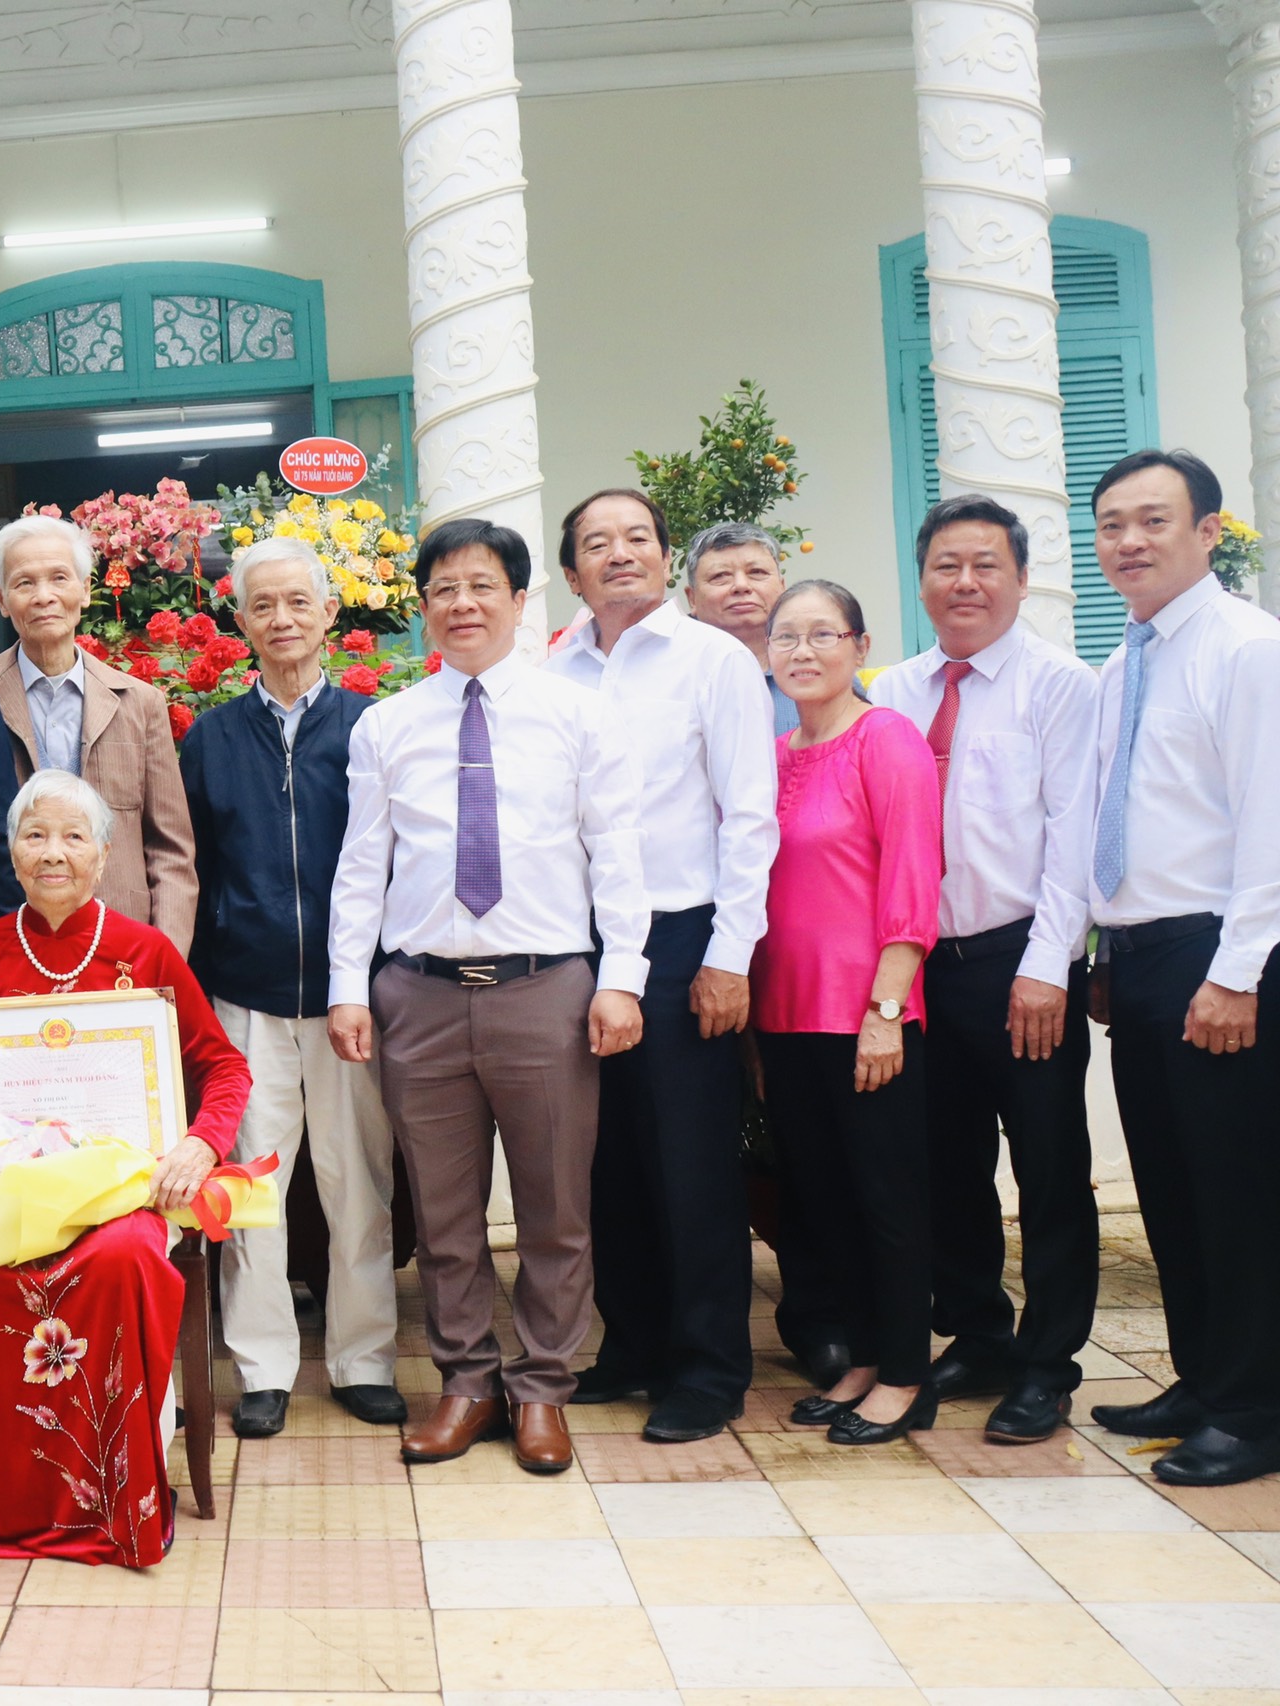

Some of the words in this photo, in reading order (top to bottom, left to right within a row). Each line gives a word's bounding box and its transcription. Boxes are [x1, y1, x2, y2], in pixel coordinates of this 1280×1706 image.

[286, 449, 320, 467] CHÚC
[323, 449, 360, 467] MỪNG
[301, 470, 308, 481] 75
[309, 468, 322, 481] NĂM
